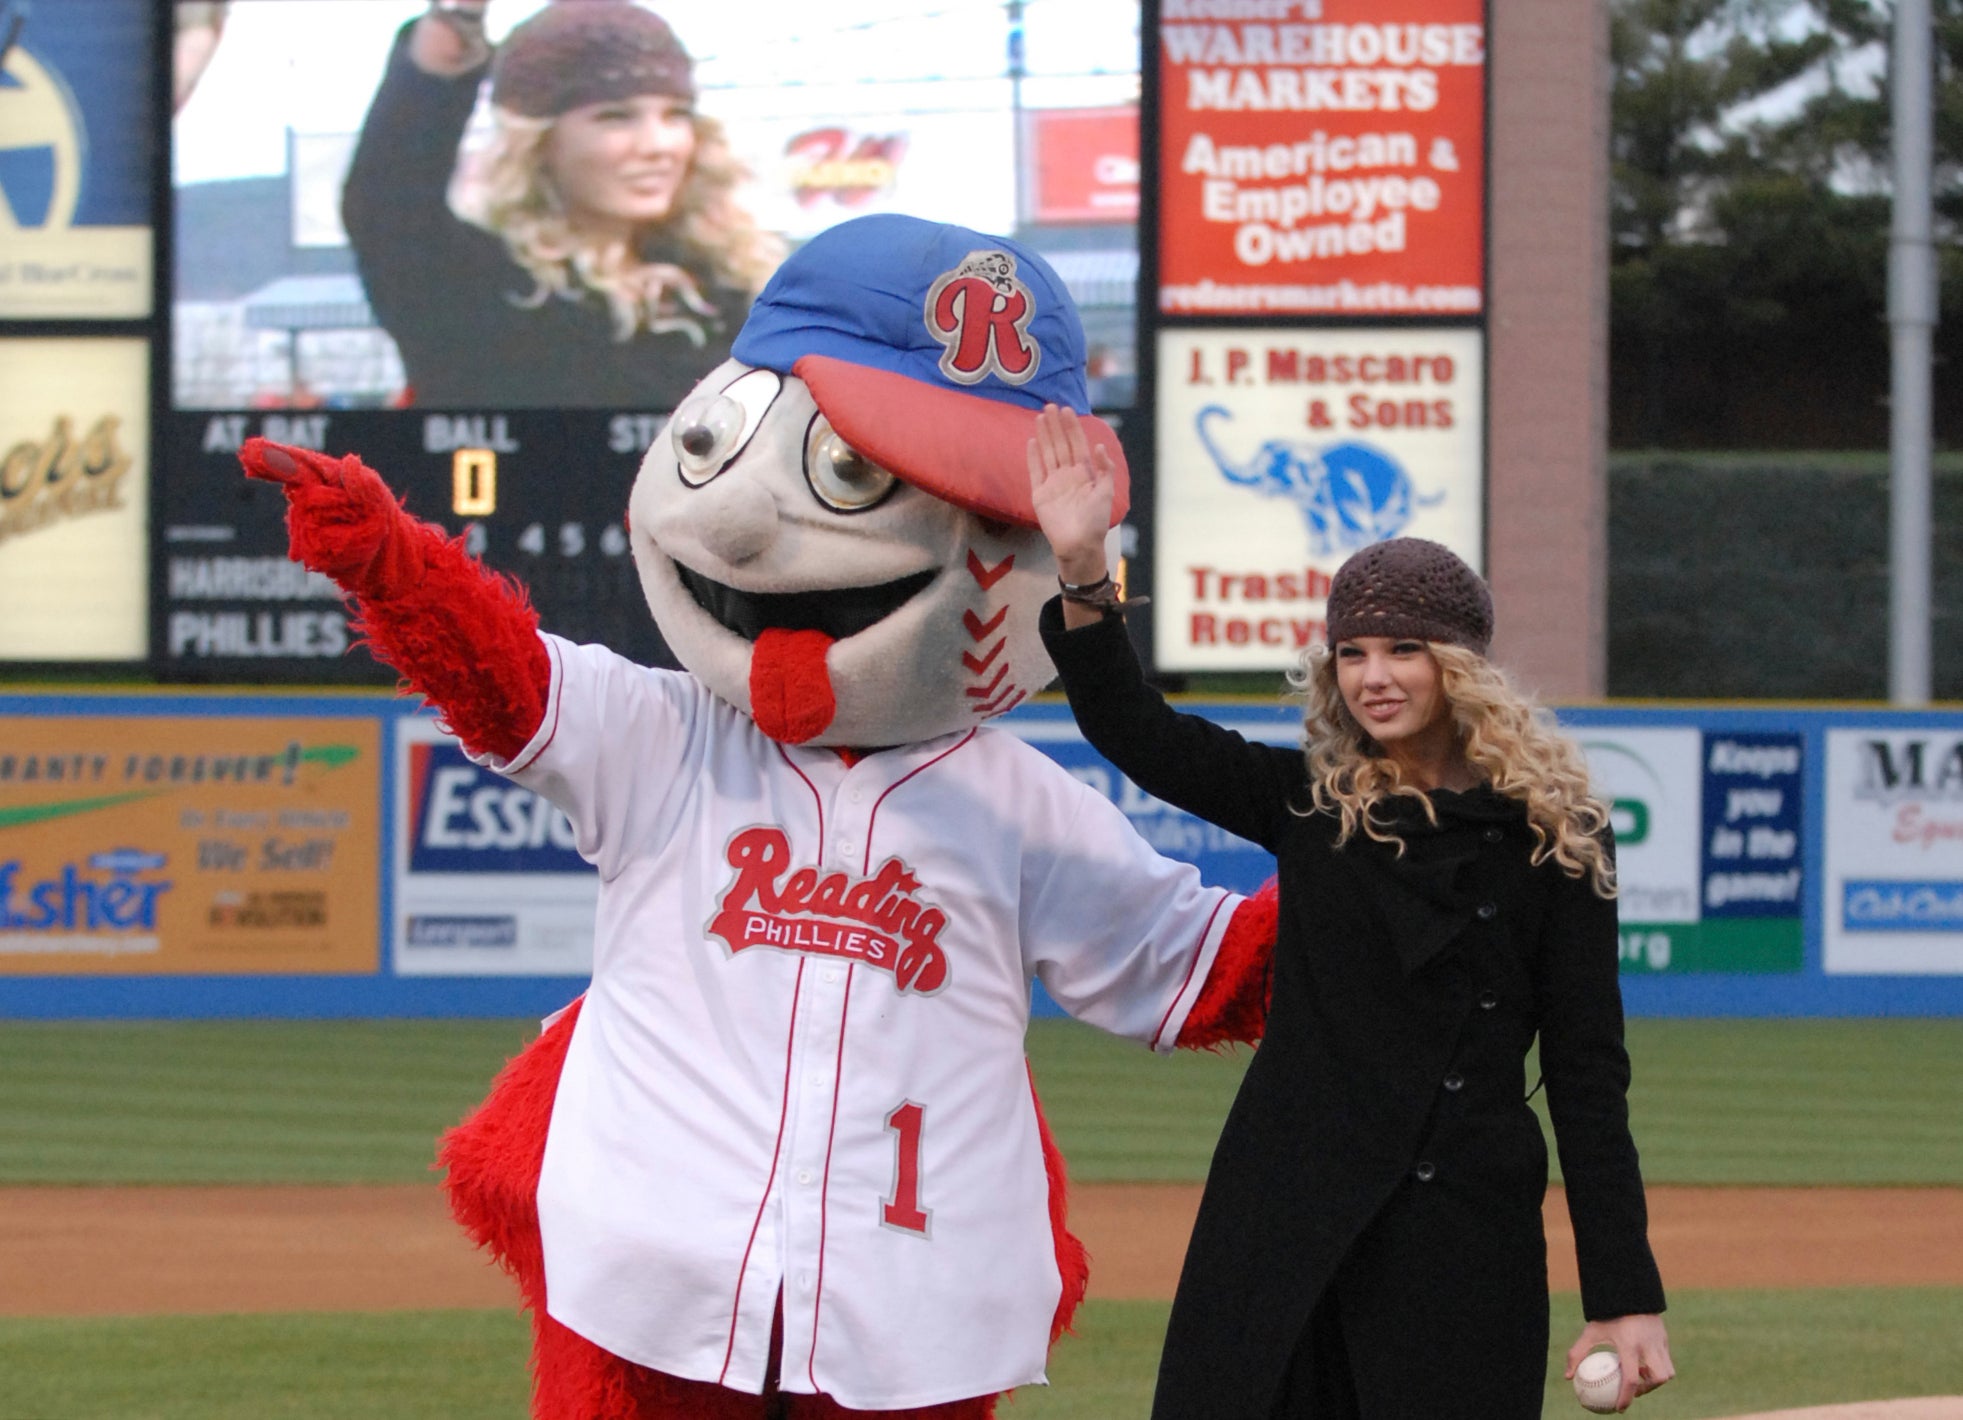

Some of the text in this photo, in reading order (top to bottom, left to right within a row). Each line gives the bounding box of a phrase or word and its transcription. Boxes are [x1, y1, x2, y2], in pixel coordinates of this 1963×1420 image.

[1160, 23, 1484, 65] WAREHOUSE
[1187, 69, 1438, 111] MARKETS
[1182, 131, 1459, 178] American &
[1202, 176, 1441, 227] Employee
[1234, 213, 1406, 265] Owned
[930, 268, 1036, 381] R
[1265, 347, 1454, 386] Mascaro
[203, 416, 249, 451] AT
[423, 415, 518, 452] BALL
[1306, 395, 1454, 430] & Sons
[453, 449, 496, 516] 0
[518, 521, 546, 557] 4
[168, 610, 348, 658] PHILLIES
[1188, 612, 1328, 648] Recy
[1710, 741, 1799, 778] Keeps
[1727, 789, 1784, 822] you
[1747, 827, 1797, 859] the
[712, 825, 951, 995] Reading
[743, 915, 886, 960] PHILLIES
[883, 1101, 931, 1236] 1
